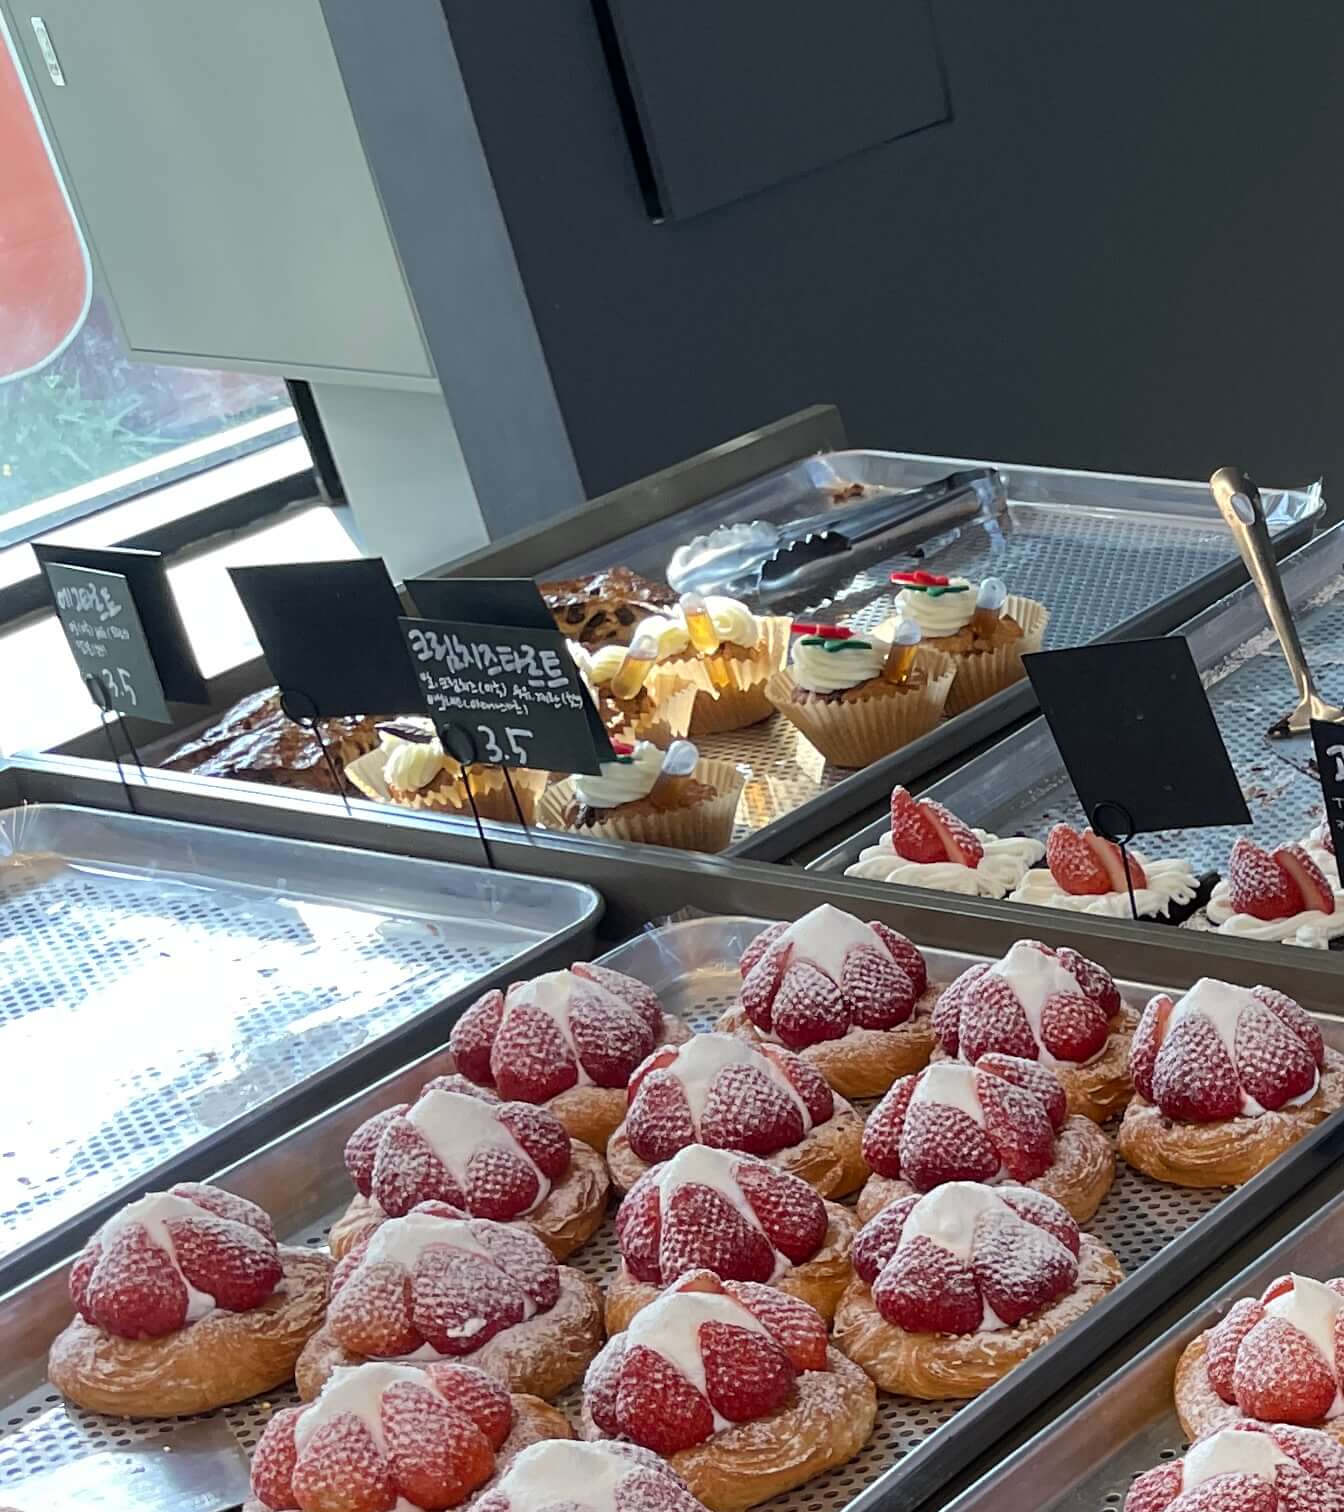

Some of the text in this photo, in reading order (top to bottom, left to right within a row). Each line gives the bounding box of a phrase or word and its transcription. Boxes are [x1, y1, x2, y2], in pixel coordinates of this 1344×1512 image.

[408, 629, 569, 688] 크림치즈타르트
[102, 667, 137, 706] 3.5
[477, 725, 534, 765] 3.5
